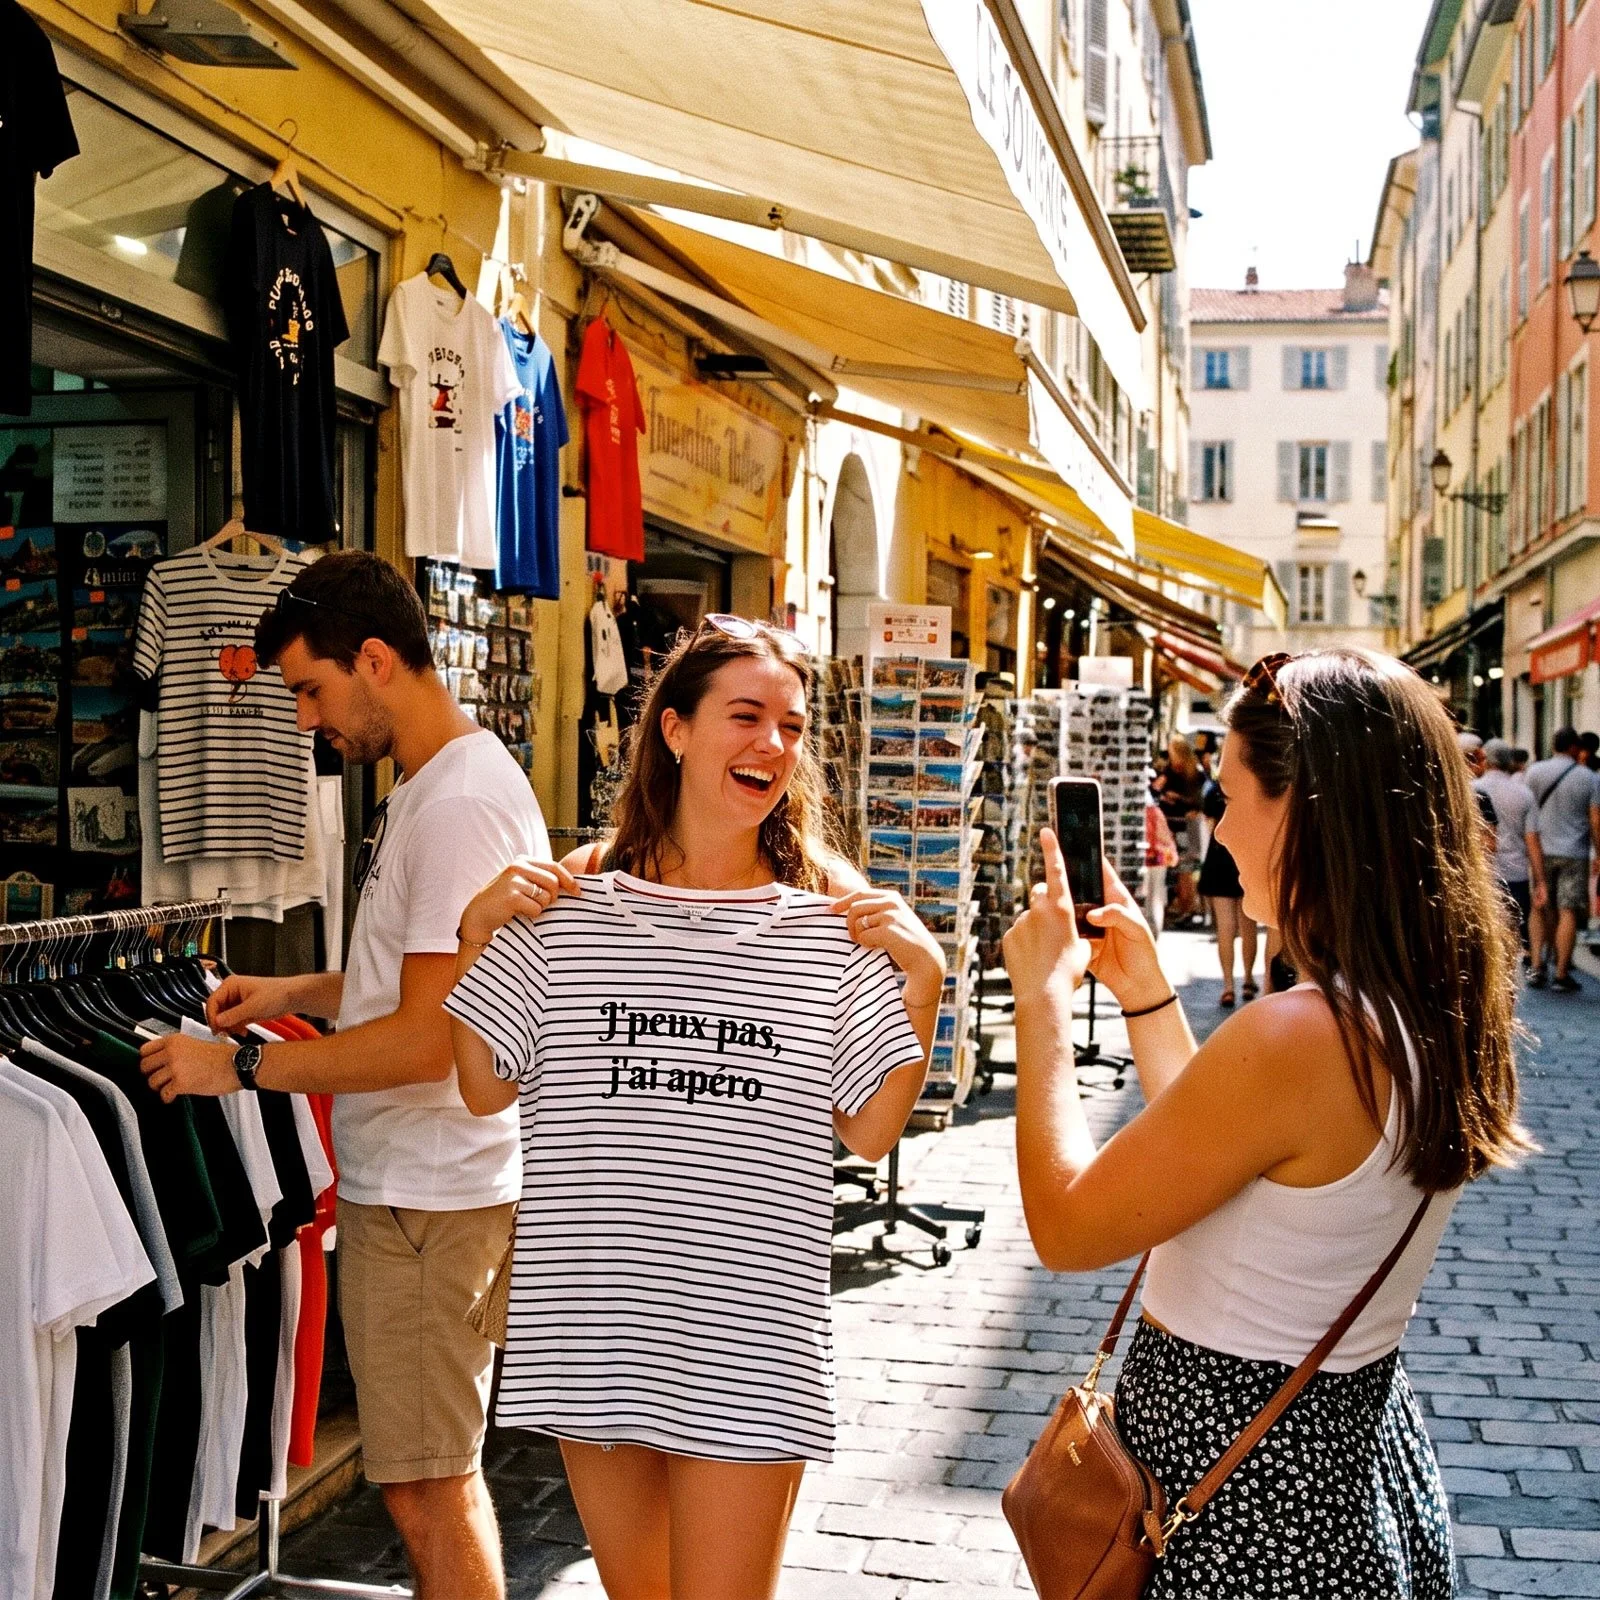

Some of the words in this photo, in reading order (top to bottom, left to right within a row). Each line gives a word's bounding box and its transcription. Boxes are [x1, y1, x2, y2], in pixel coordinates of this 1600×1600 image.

[598, 1001, 708, 1046] J'peux
[716, 1019, 782, 1058] pas,
[601, 1057, 658, 1100] j'ai
[667, 1066, 762, 1105] apéro
